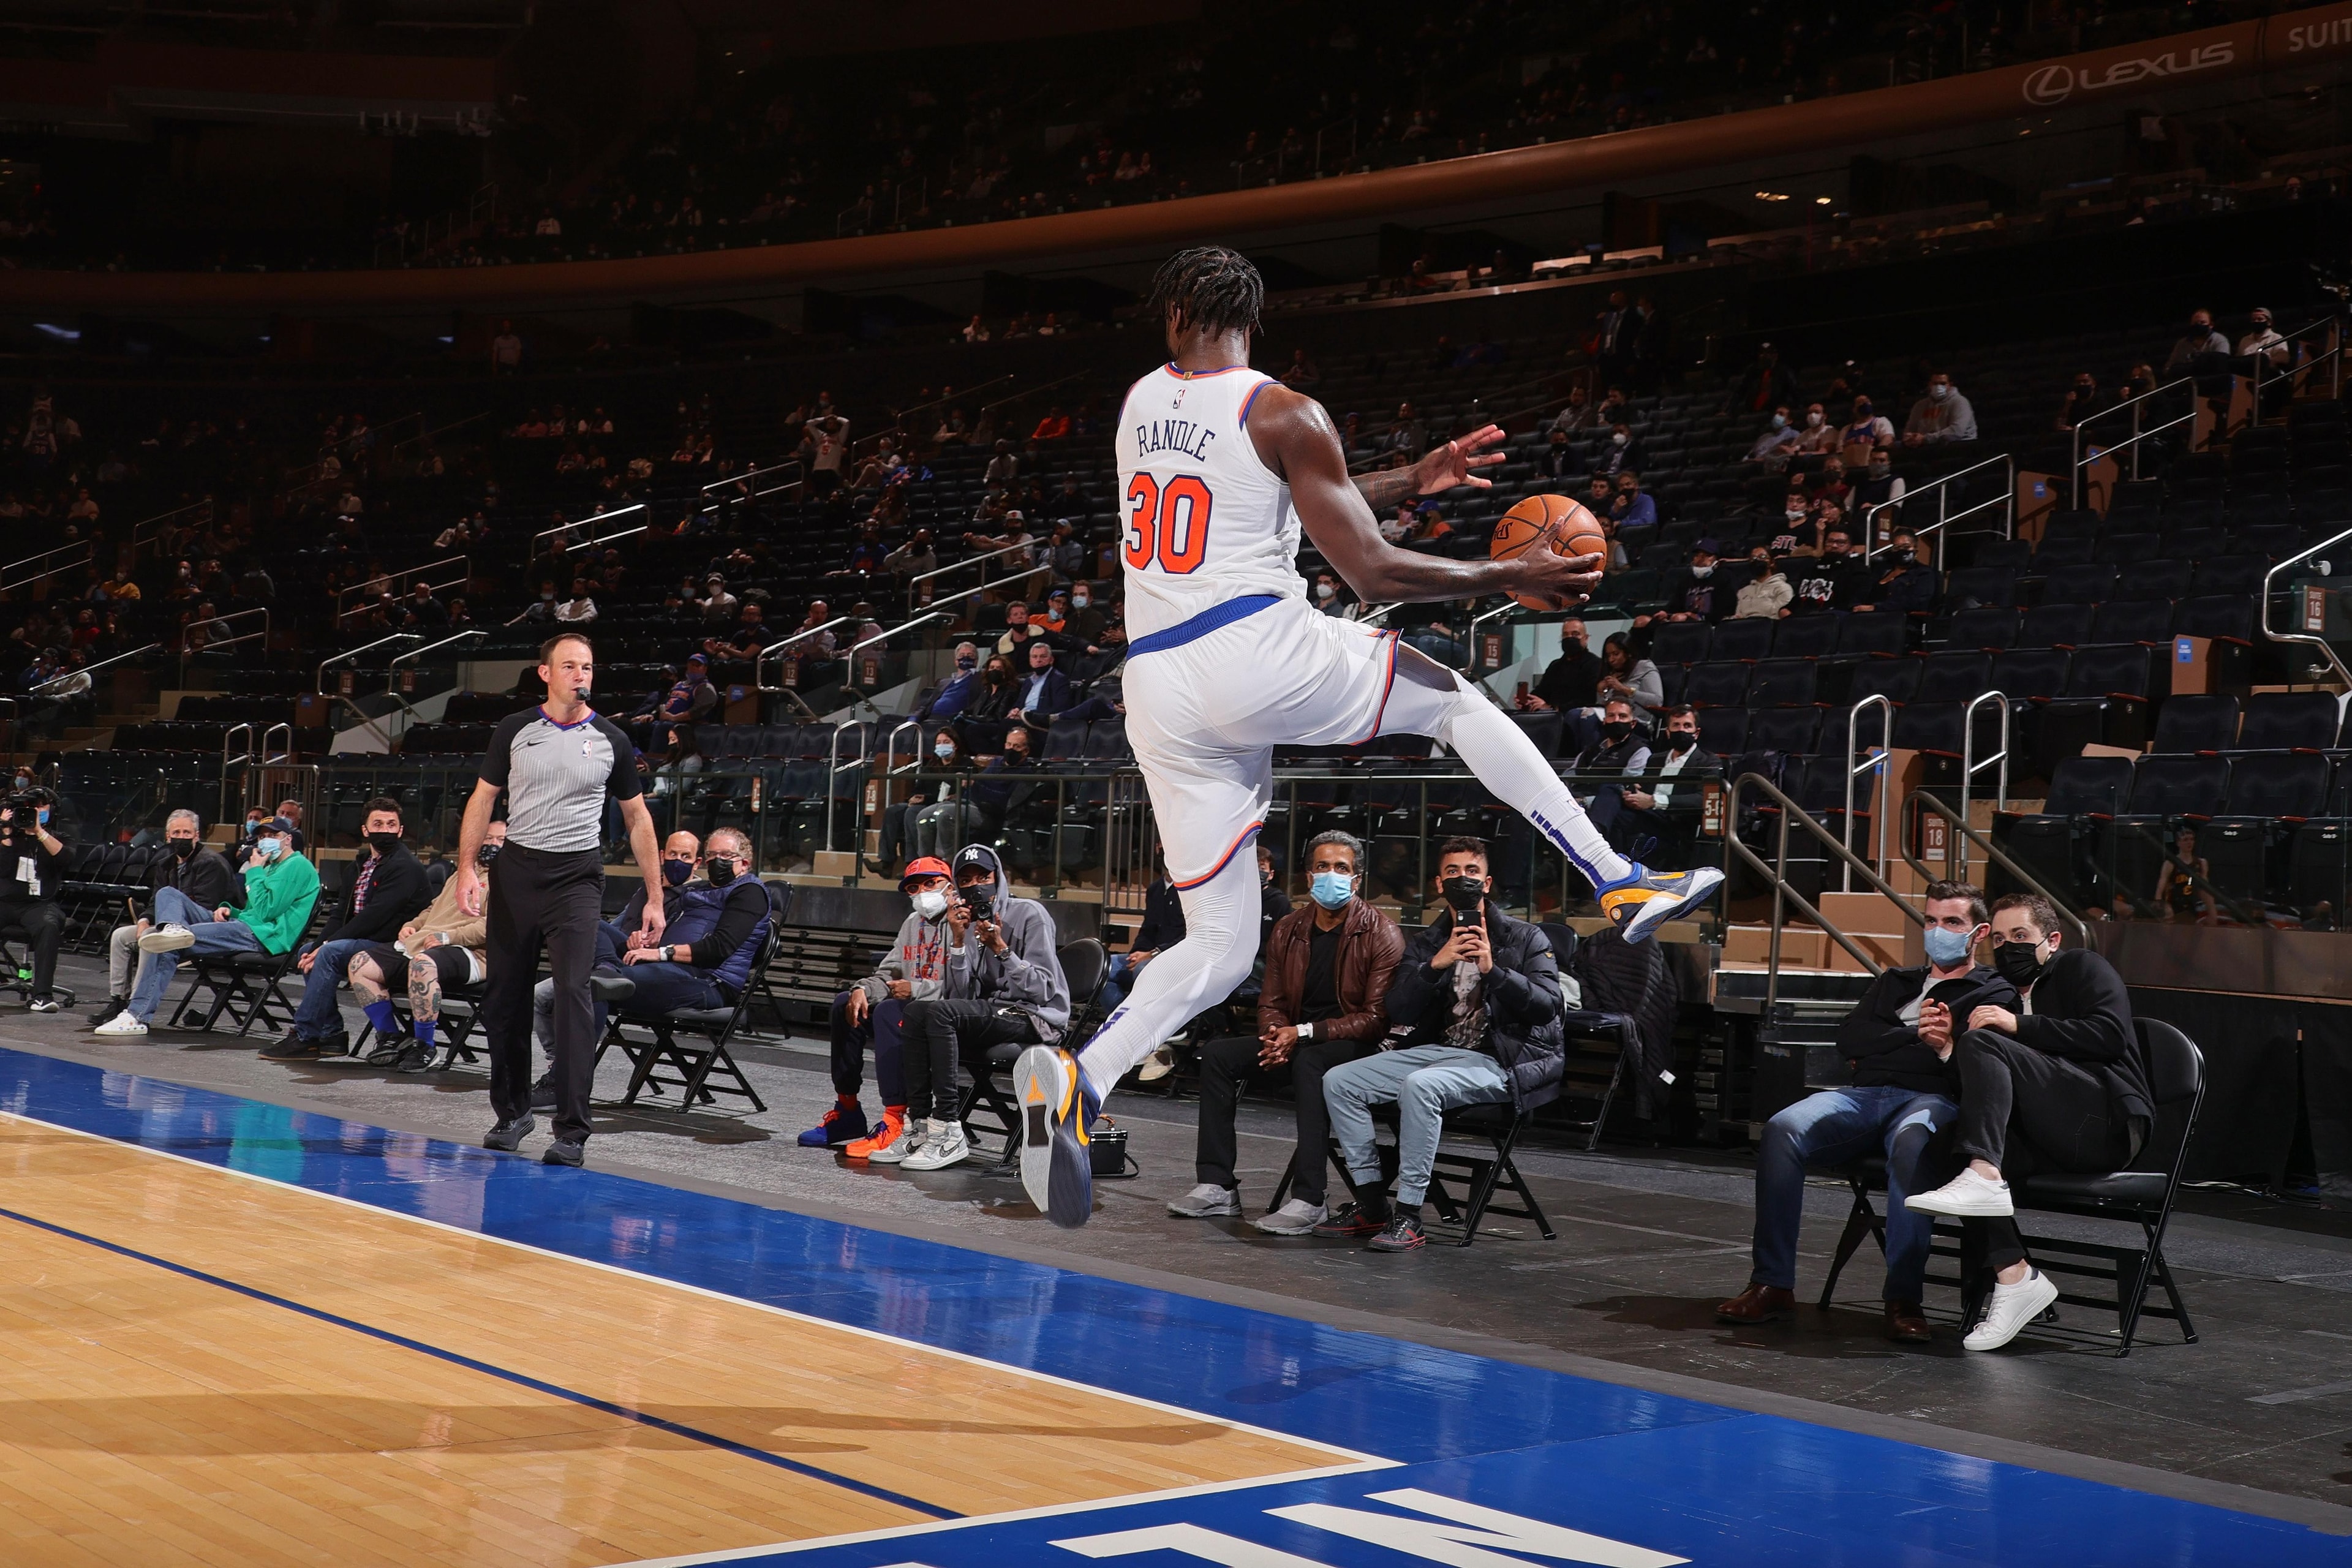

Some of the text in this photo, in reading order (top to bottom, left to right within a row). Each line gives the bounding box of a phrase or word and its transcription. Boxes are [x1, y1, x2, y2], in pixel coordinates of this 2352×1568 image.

[2080, 41, 2233, 90] LEXUS
[1137, 420, 1215, 462] RANDLE
[1126, 472, 1213, 575] 30
[2310, 601, 2321, 616] 16
[1488, 645, 1498, 658] 15
[787, 668, 796, 678] 12
[866, 666, 874, 676] 13
[1705, 800, 1724, 816] 5-6
[1929, 829, 1943, 846] 18
